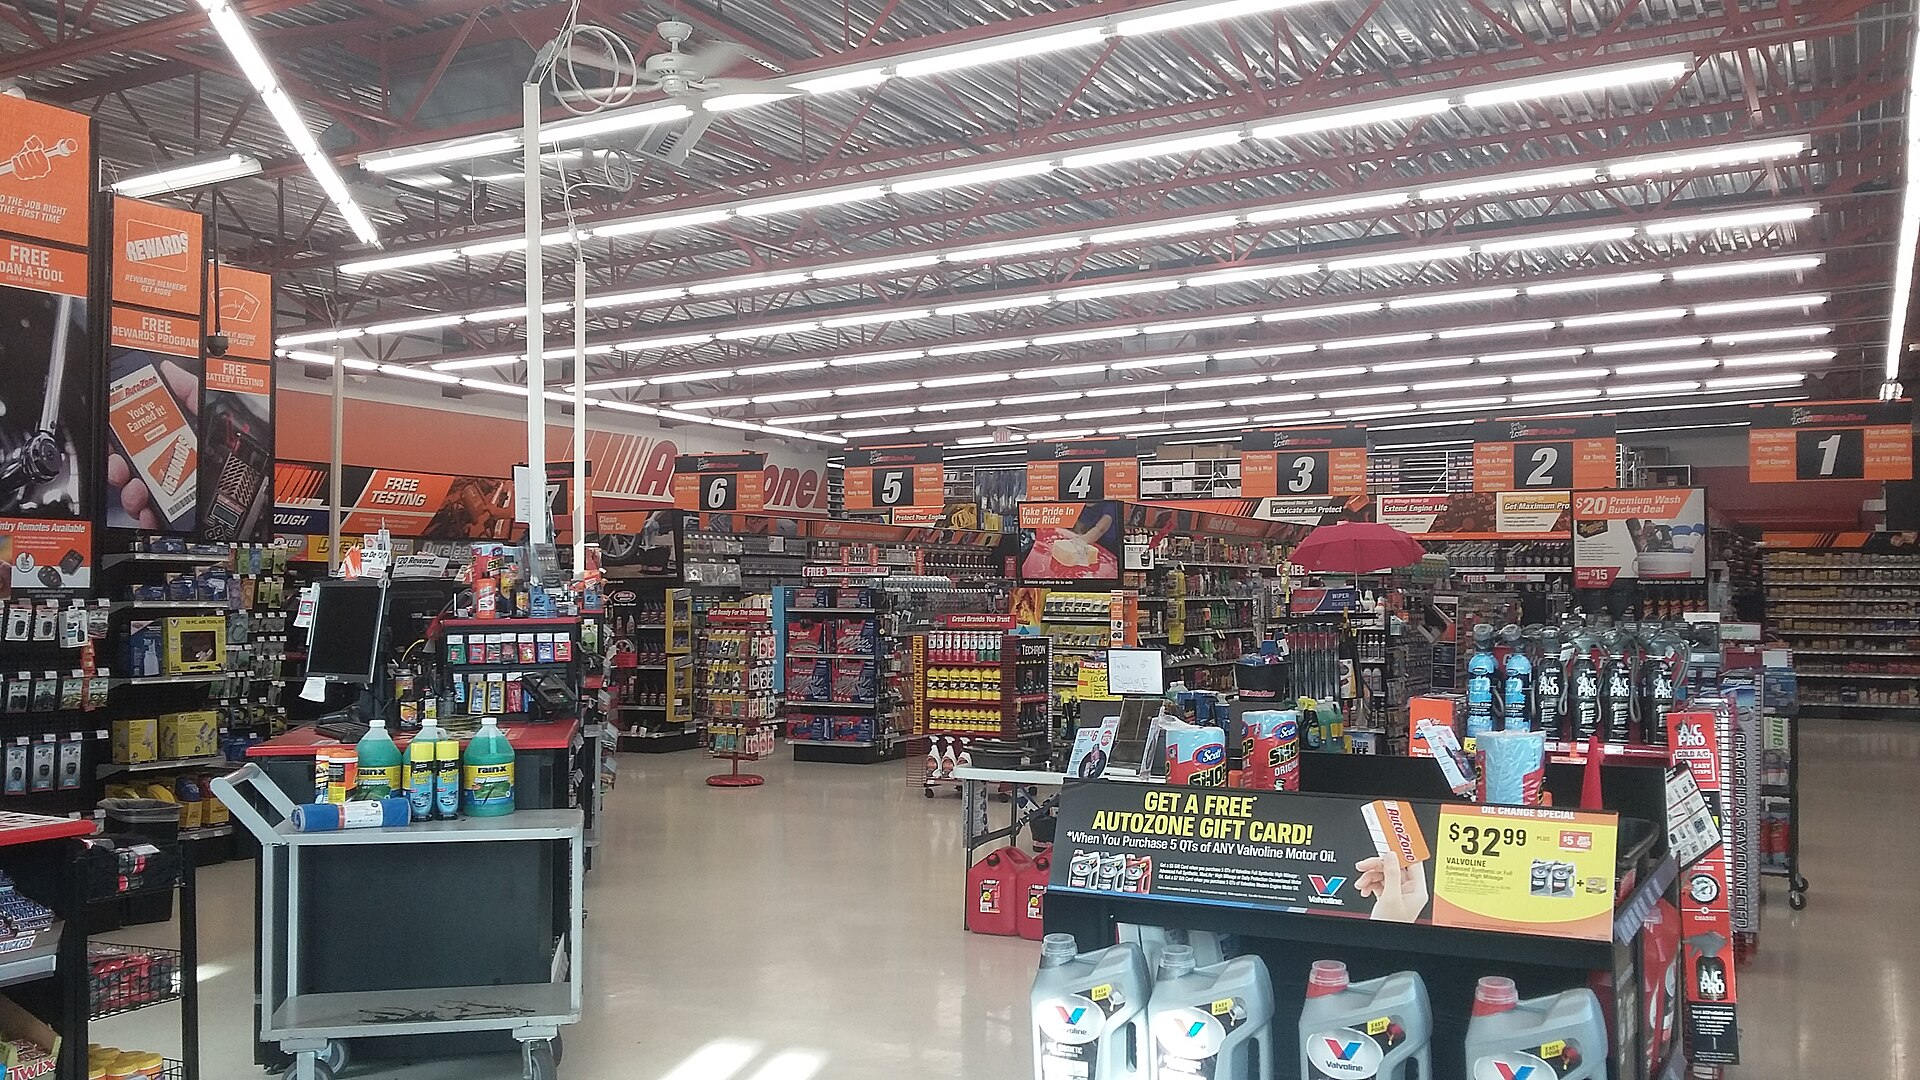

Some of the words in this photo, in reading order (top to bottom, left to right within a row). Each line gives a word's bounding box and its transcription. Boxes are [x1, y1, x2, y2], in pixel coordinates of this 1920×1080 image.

[8, 196, 23, 207] THE
[24, 201, 40, 210] JOB
[43, 204, 67, 216] RIGHT
[0, 205, 14, 214] THE
[17, 208, 40, 219] FIRST
[42, 213, 62, 224] TIME
[126, 232, 188, 262] REWARDS
[10, 244, 50, 268] FREE
[125, 274, 156, 287] REWARDS
[157, 281, 188, 292] MEMBERS
[141, 285, 152, 294] GET
[154, 287, 172, 297] MORE
[142, 316, 172, 334] FREE
[112, 326, 156, 342] REWARDS
[157, 332, 199, 349] PROGRAM
[222, 362, 246, 376] FREE
[125, 376, 158, 397] AutoZone
[206, 372, 234, 384] BATTERY
[236, 375, 264, 387] TESTING
[127, 400, 156, 421] You've
[126, 411, 157, 433] Earned
[1818, 434, 1842, 475] 1
[161, 434, 192, 496] REWARDS
[1526, 447, 1558, 486] 2
[1288, 456, 1314, 492] 3
[384, 476, 420, 492] FREE
[881, 472, 904, 504] 5
[1068, 466, 1092, 498] 4
[370, 491, 426, 508] TESTING
[708, 478, 728, 509] 6
[1022, 507, 1040, 516] Take
[1042, 507, 1064, 516] Pride
[1066, 507, 1074, 516] In
[1556, 502, 1570, 510] Pro
[1576, 497, 1607, 515] $20
[1610, 496, 1652, 504] Premium
[1654, 496, 1680, 504] Wash
[1608, 506, 1640, 514] Bucket
[1643, 504, 1664, 514] Deal
[17, 522, 50, 532] Remotes
[51, 523, 86, 532] Available
[1022, 516, 1040, 524] Your
[1042, 516, 1060, 524] Ride
[286, 539, 302, 548] YEAR
[397, 556, 408, 566] $20
[408, 557, 435, 565] Reward
[806, 568, 826, 576] FREE
[1591, 569, 1608, 580] $15
[1022, 644, 1046, 657] TECHRON
[1541, 676, 1558, 686] A/C
[1612, 677, 1629, 688] A/C
[1540, 686, 1560, 696] PRO
[1610, 687, 1630, 697] PRO
[1680, 724, 1702, 736] A/C
[1678, 735, 1706, 746] PRO
[1203, 748, 1222, 763] Scott
[1736, 733, 1746, 785] CHARGE
[1144, 791, 1180, 812] GET
[1184, 794, 1200, 815] A
[1481, 805, 1496, 814] OIL
[1498, 806, 1536, 818] CHANGE
[1537, 809, 1576, 820] SPECIAL
[1736, 806, 1747, 817] &
[1092, 810, 1195, 838] AUTOZONE
[1198, 815, 1246, 840] GIFT
[1249, 821, 1314, 846] CARD!
[1386, 808, 1415, 863] AutoZone
[1736, 820, 1747, 851] STAY
[1102, 834, 1120, 847] You
[1122, 836, 1168, 850] Purchase
[1170, 840, 1177, 850] 5
[1179, 840, 1198, 852] QTs
[1200, 841, 1212, 852] of
[1212, 842, 1235, 855] ANY
[1236, 844, 1284, 859] Valvoline
[1285, 848, 1318, 862] Motor
[1320, 850, 1337, 863] Oil.
[1562, 836, 1574, 846] $5
[1446, 857, 1486, 868] VALVOLINE
[1472, 867, 1495, 875] Synthetic
[1736, 853, 1748, 928] CONNECTED
[1308, 896, 1344, 906] Valvoline
[1702, 970, 1722, 982] A/C
[1700, 981, 1724, 994] PRO
[1545, 1049, 1560, 1057] POUR
[1326, 1060, 1364, 1072] Valvoline
